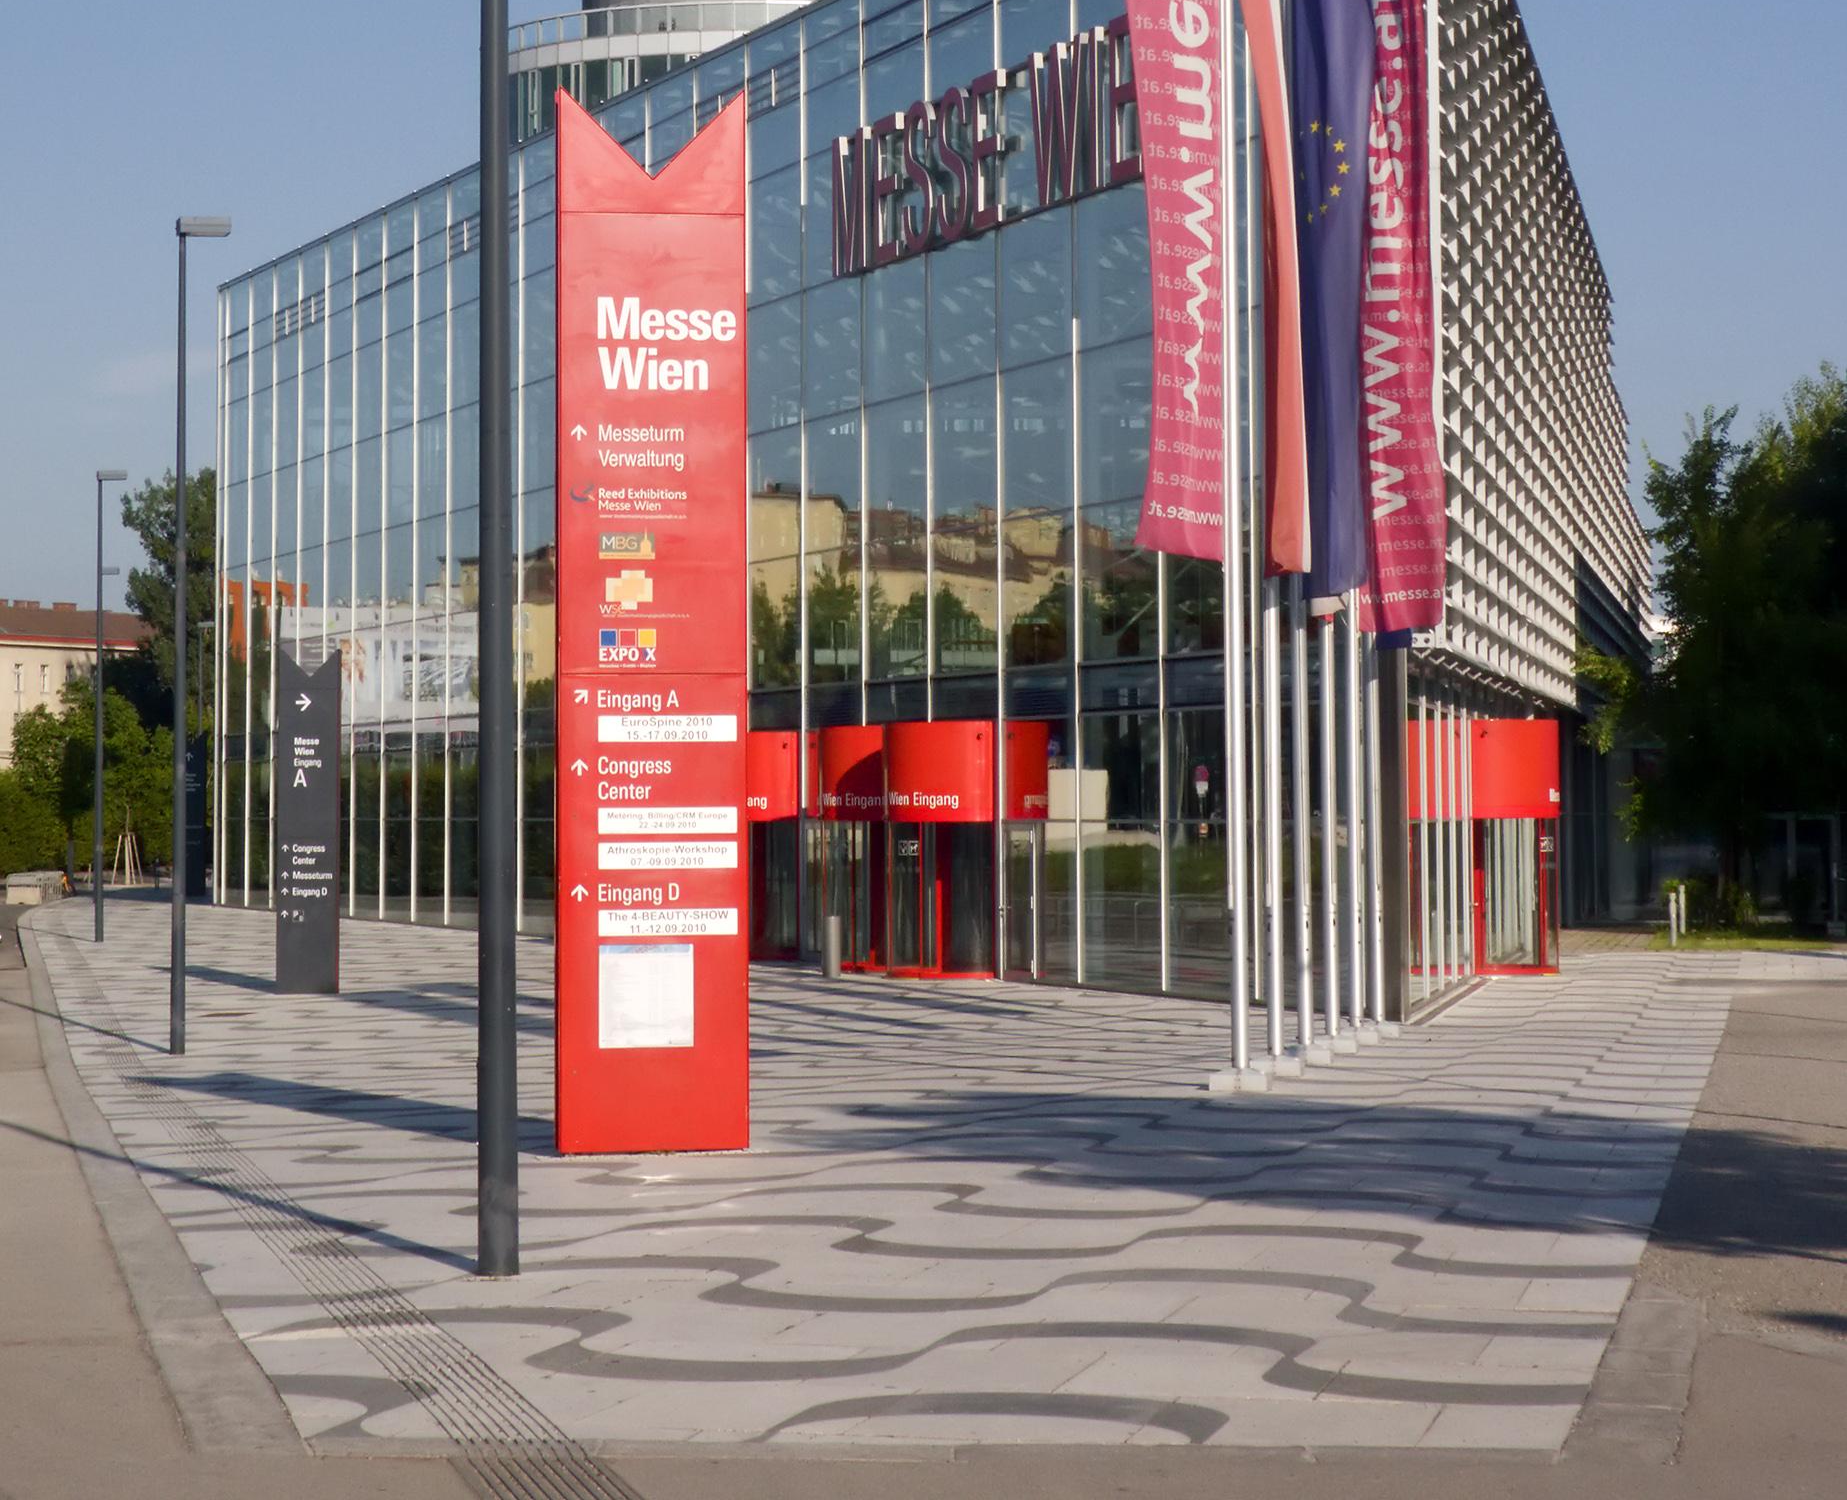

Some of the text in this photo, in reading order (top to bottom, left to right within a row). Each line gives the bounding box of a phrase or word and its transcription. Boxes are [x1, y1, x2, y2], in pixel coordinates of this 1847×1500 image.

[832, 68, 1006, 277] MESSE
[1028, 13, 1144, 205] WIE
[597, 296, 736, 341] Messe
[597, 347, 709, 391] Wien
[598, 424, 684, 442] Messeturm
[598, 450, 685, 472] Verwaltung
[598, 487, 687, 500] Reed Exhibitions
[598, 500, 661, 511] Messe Wien
[602, 535, 637, 550] MBG
[597, 689, 679, 711] Eingang A
[621, 717, 713, 728] EuroSpine 2010
[294, 737, 320, 745] Messe
[294, 747, 315, 756] Wien
[294, 758, 322, 768] Eingang
[598, 756, 672, 778] Congress
[293, 769, 307, 787] A
[598, 781, 651, 800] Center
[888, 791, 960, 810] Wien Eingang
[292, 843, 326, 854] Congress
[292, 856, 316, 865] Center
[292, 870, 333, 880] Messeturm
[292, 886, 328, 898] Eingang D
[598, 883, 680, 906] Eingang D
[608, 910, 729, 921] The 4-BEAUTY-SHOW
